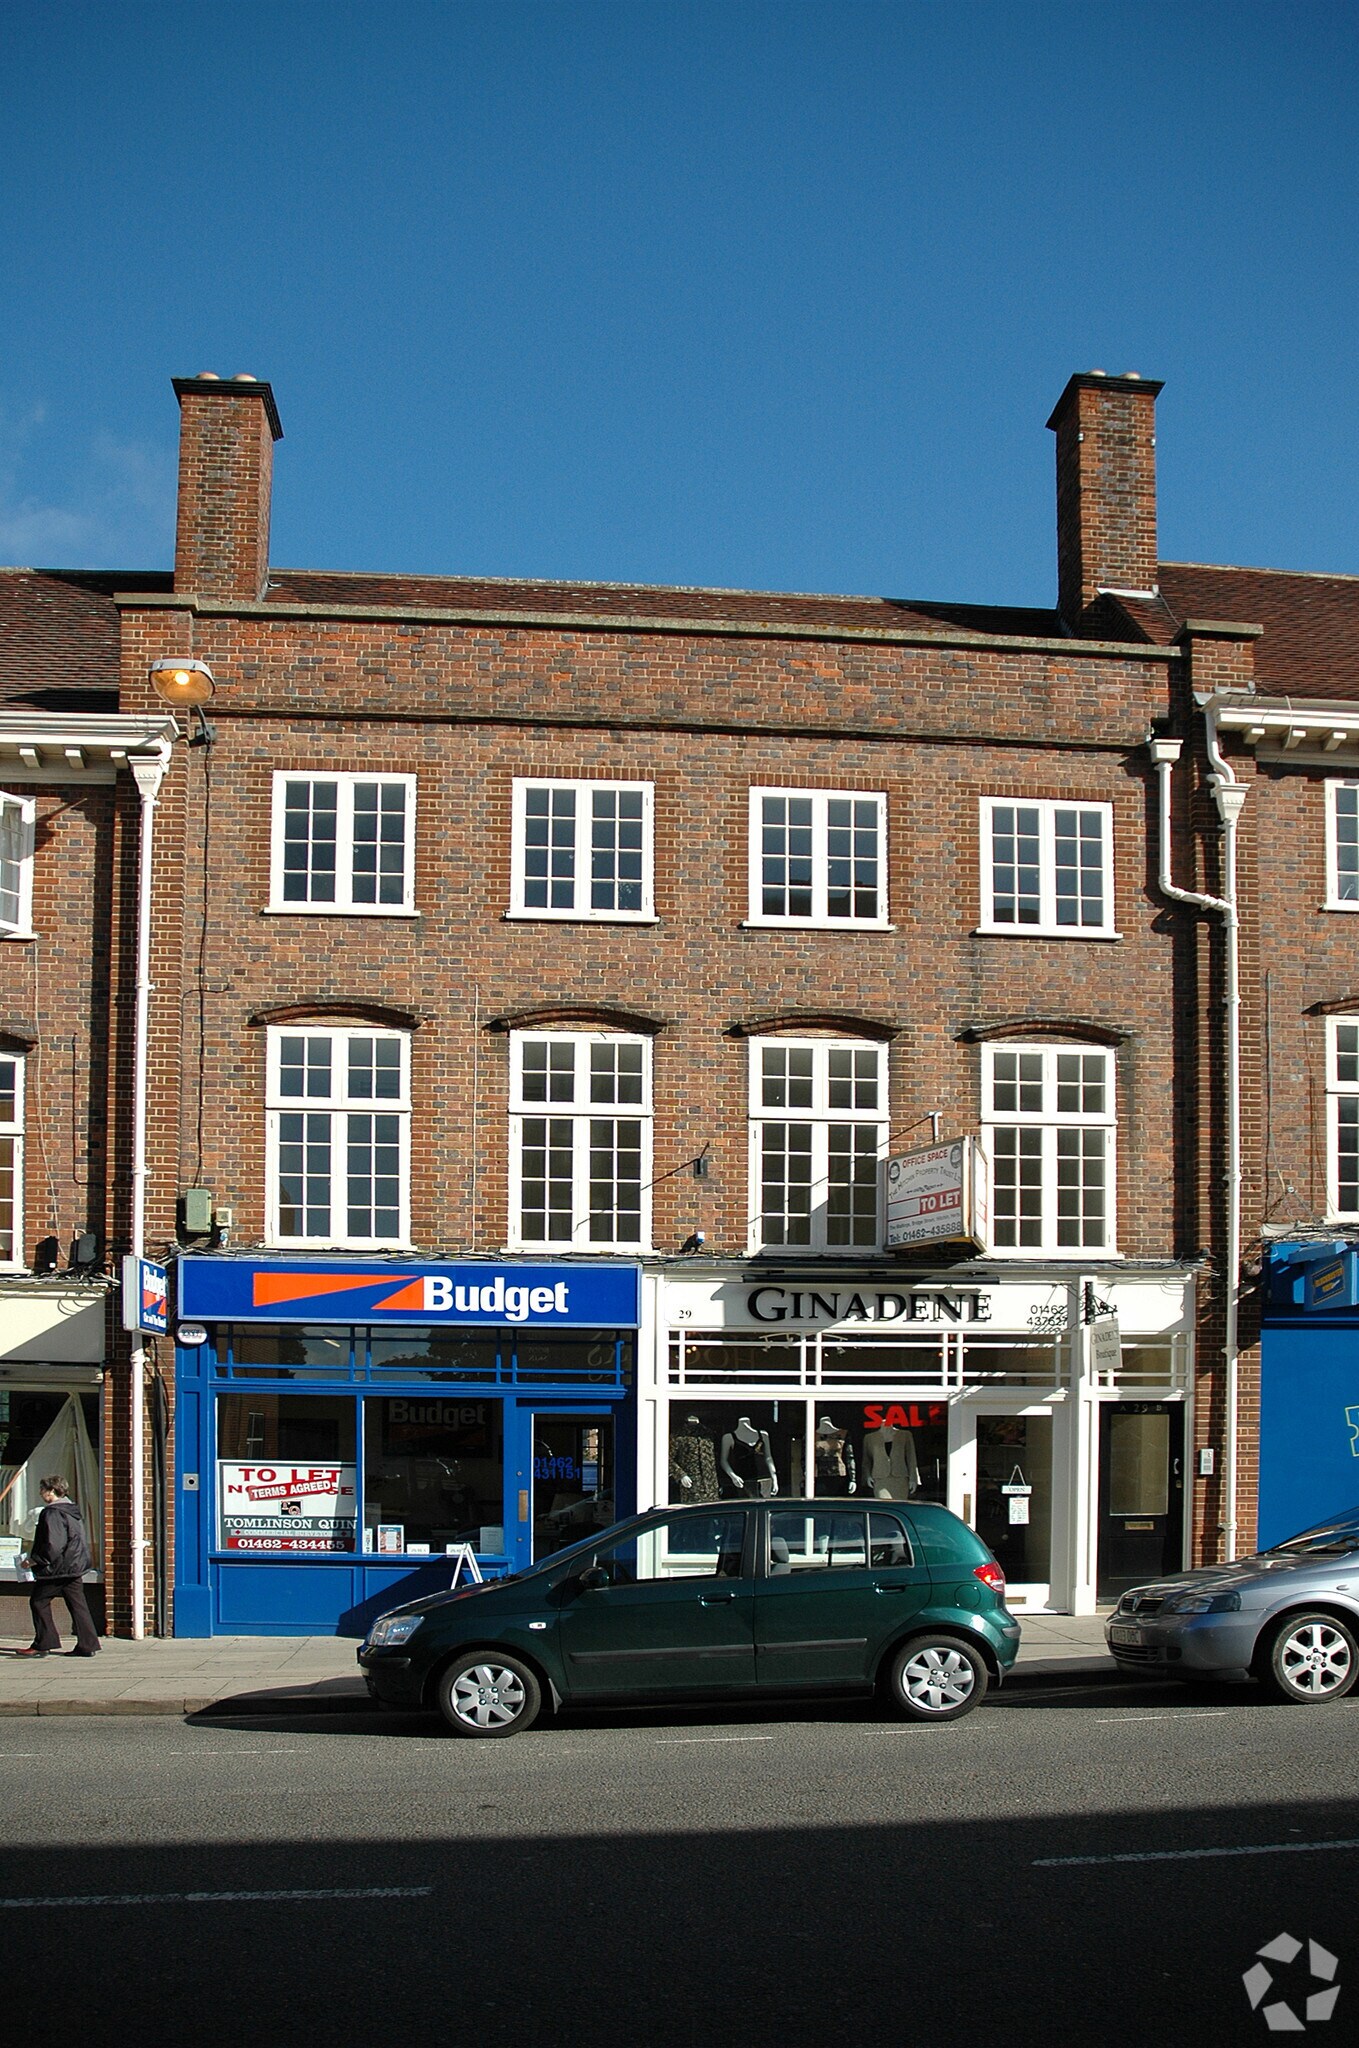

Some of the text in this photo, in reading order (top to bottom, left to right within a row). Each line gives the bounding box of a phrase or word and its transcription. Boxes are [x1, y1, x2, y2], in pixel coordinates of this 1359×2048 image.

[902, 1155, 926, 1169] OFFICE
[927, 1148, 948, 1162] SPACE
[920, 1191, 960, 1211] TO LET
[424, 1275, 569, 1321] Budget
[747, 1286, 992, 1322] GINADENE
[678, 1309, 692, 1319] 29
[388, 1399, 486, 1431] Budget
[1134, 1403, 1149, 1413] 29
[534, 1456, 573, 1469] 01462
[238, 1468, 343, 1482] TO LET
[252, 1486, 287, 1499] TERMS
[290, 1480, 330, 1494] AGREED
[224, 1518, 312, 1529] TOMLINSON
[237, 1538, 346, 1549] 01462-434455
